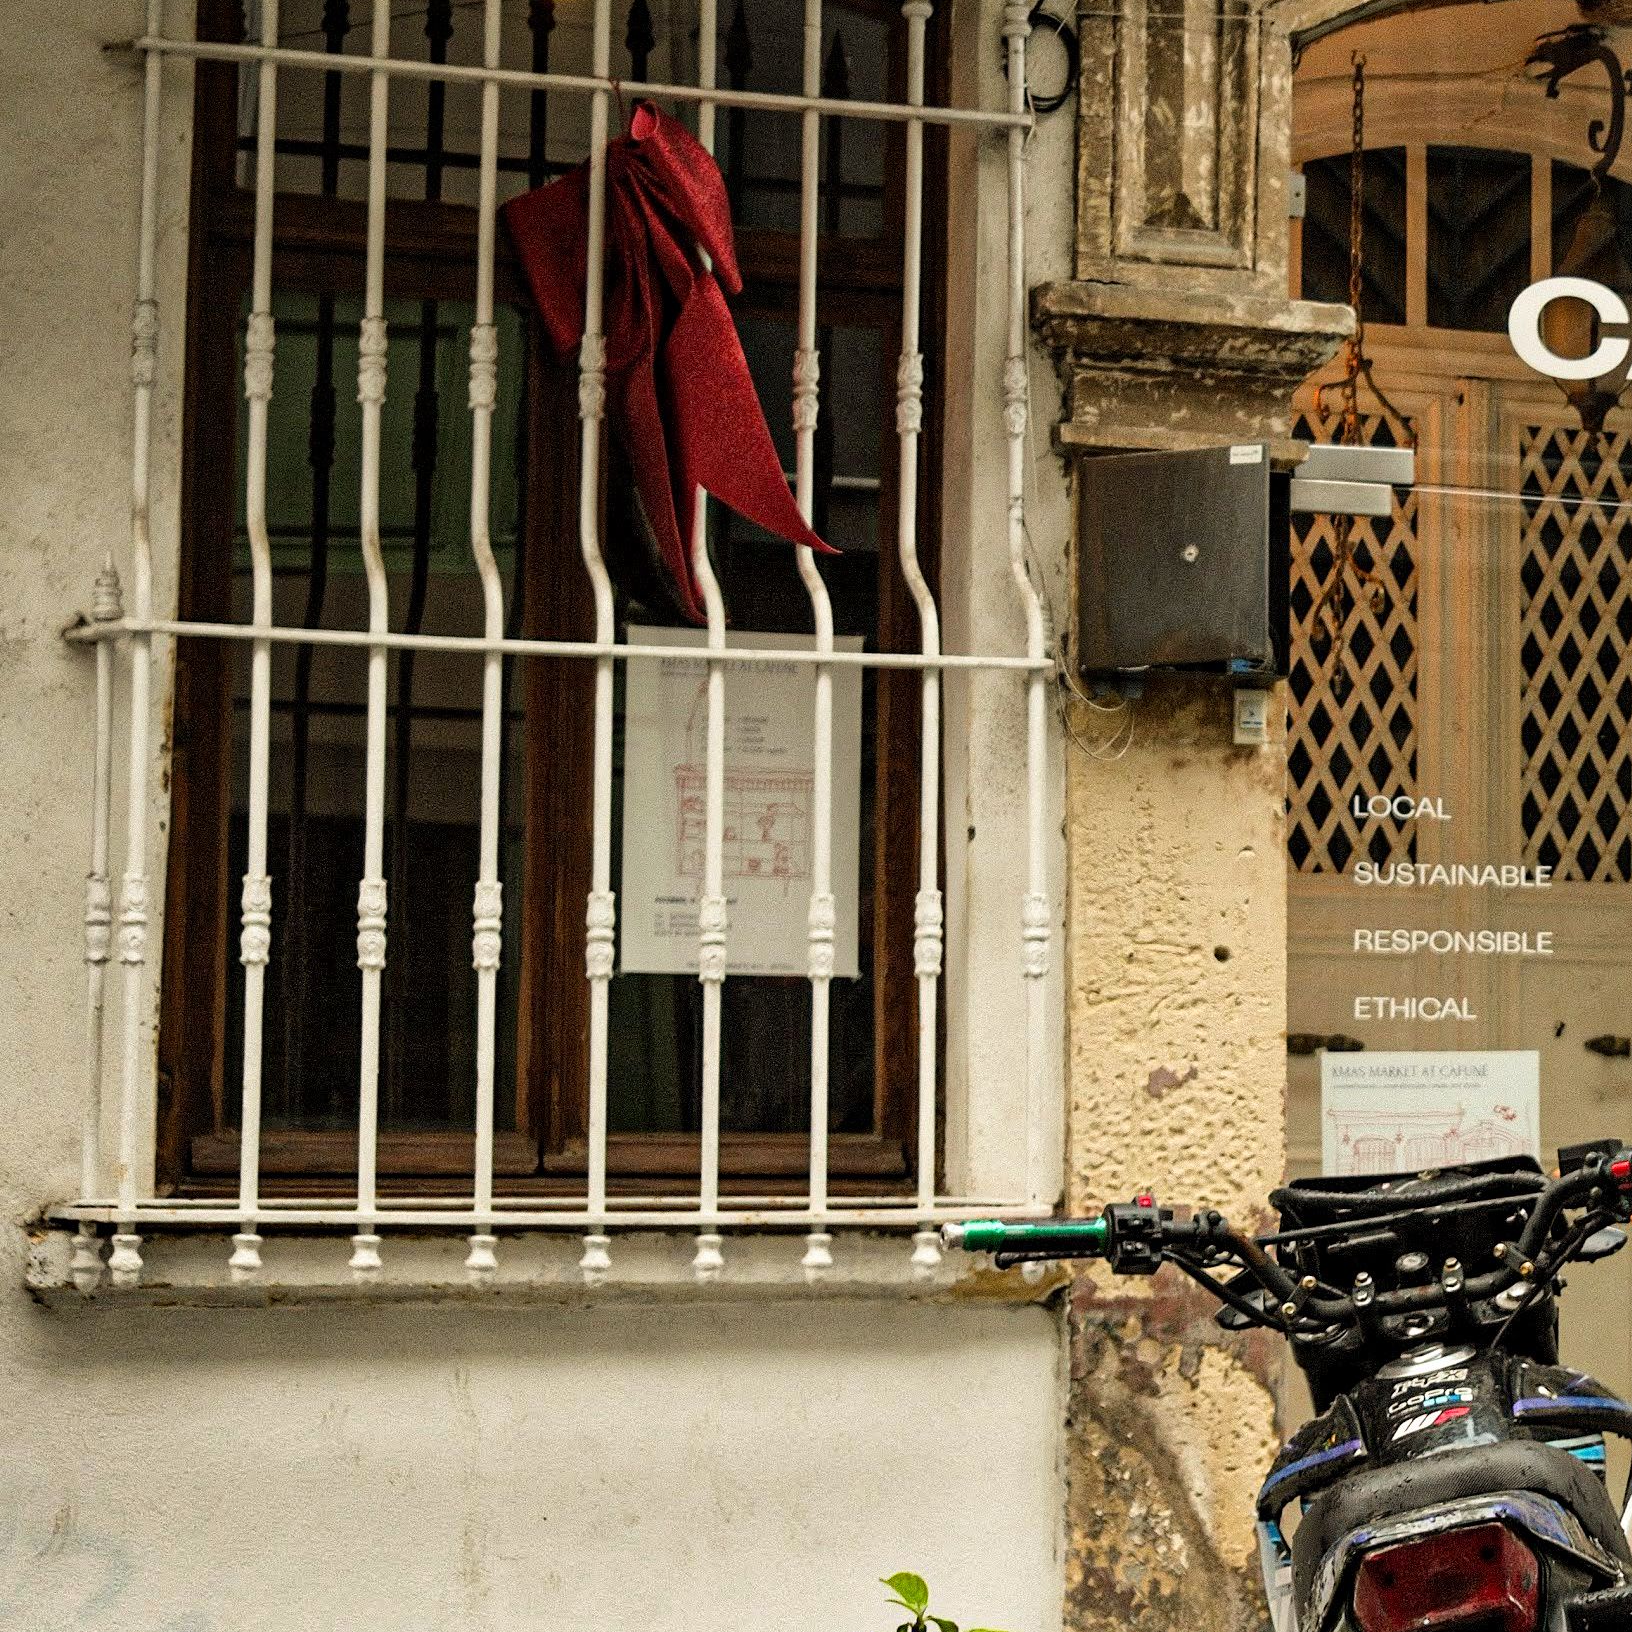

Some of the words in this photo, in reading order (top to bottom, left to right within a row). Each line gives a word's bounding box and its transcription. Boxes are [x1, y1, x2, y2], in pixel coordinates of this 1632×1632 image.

[1353, 794, 1452, 820] LOCAL
[1354, 862, 1553, 887] SUSTAINABLE
[1354, 928, 1554, 954] RESPONSIBLE
[1354, 996, 1478, 1022] ETHICAL
[1388, 1387, 1473, 1414] GoPro
